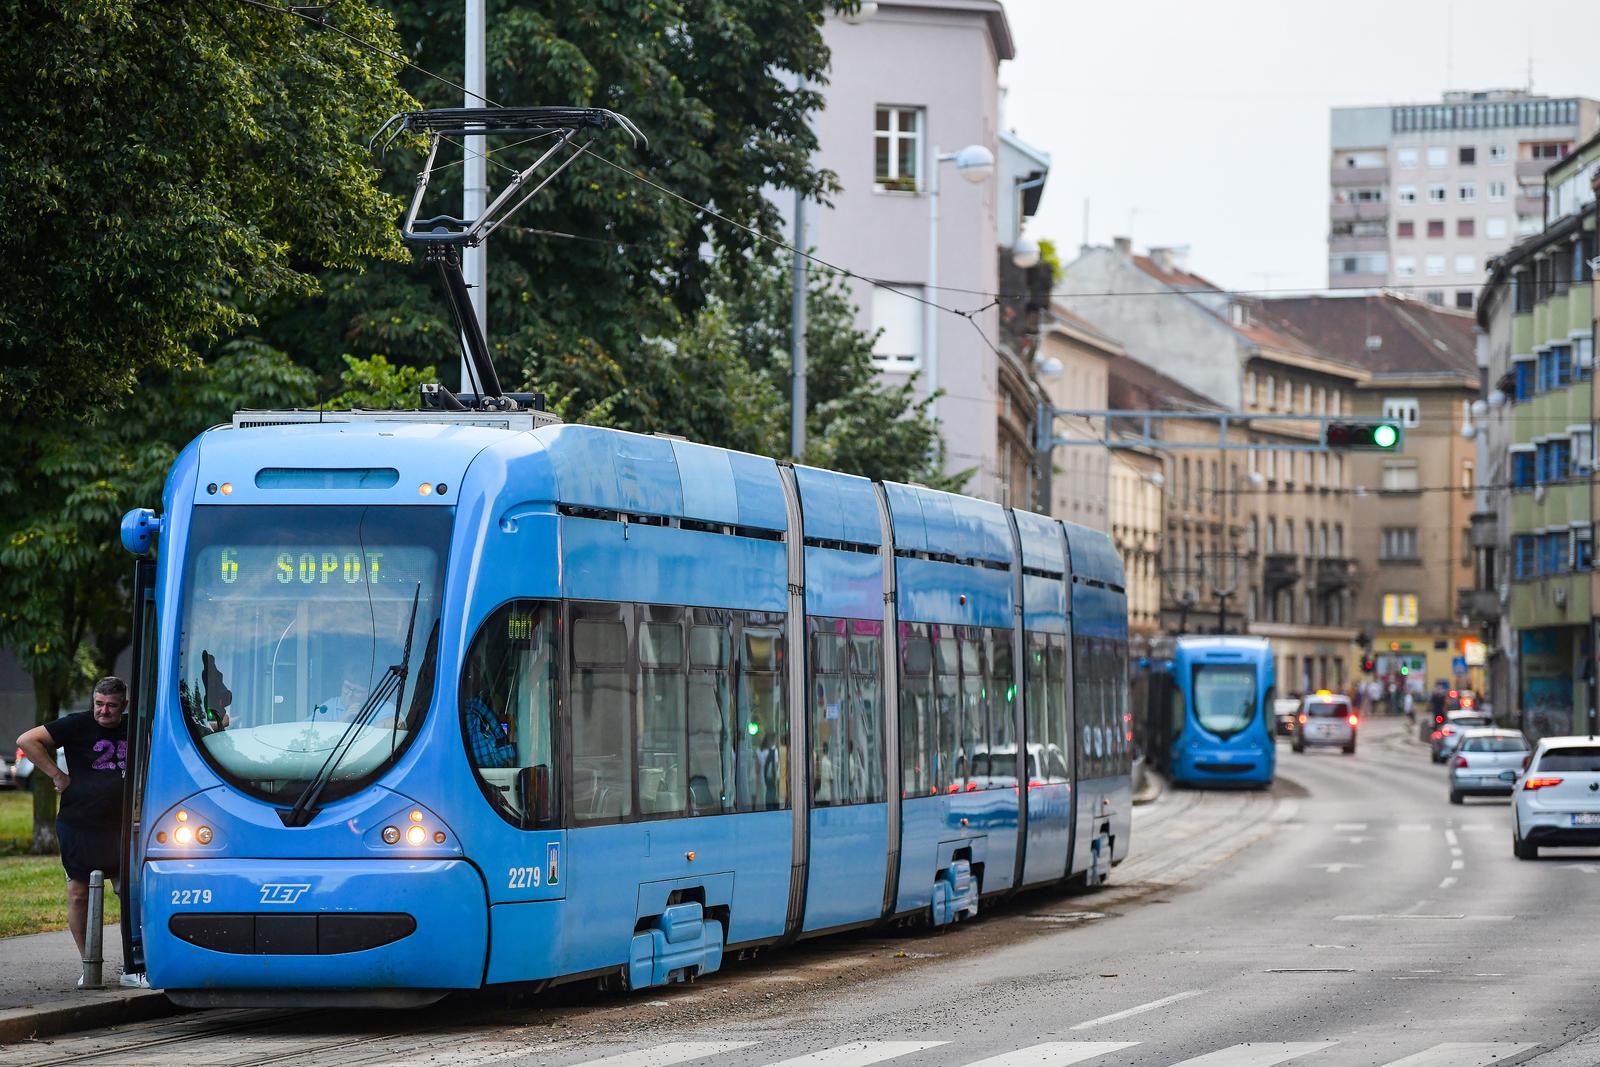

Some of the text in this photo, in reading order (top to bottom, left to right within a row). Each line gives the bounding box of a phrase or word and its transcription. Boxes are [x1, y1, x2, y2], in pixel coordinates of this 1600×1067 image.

[221, 549, 384, 584] 6 SOPOT
[508, 866, 541, 889] 2279
[171, 889, 212, 905] 2279
[259, 883, 312, 904] ZET
